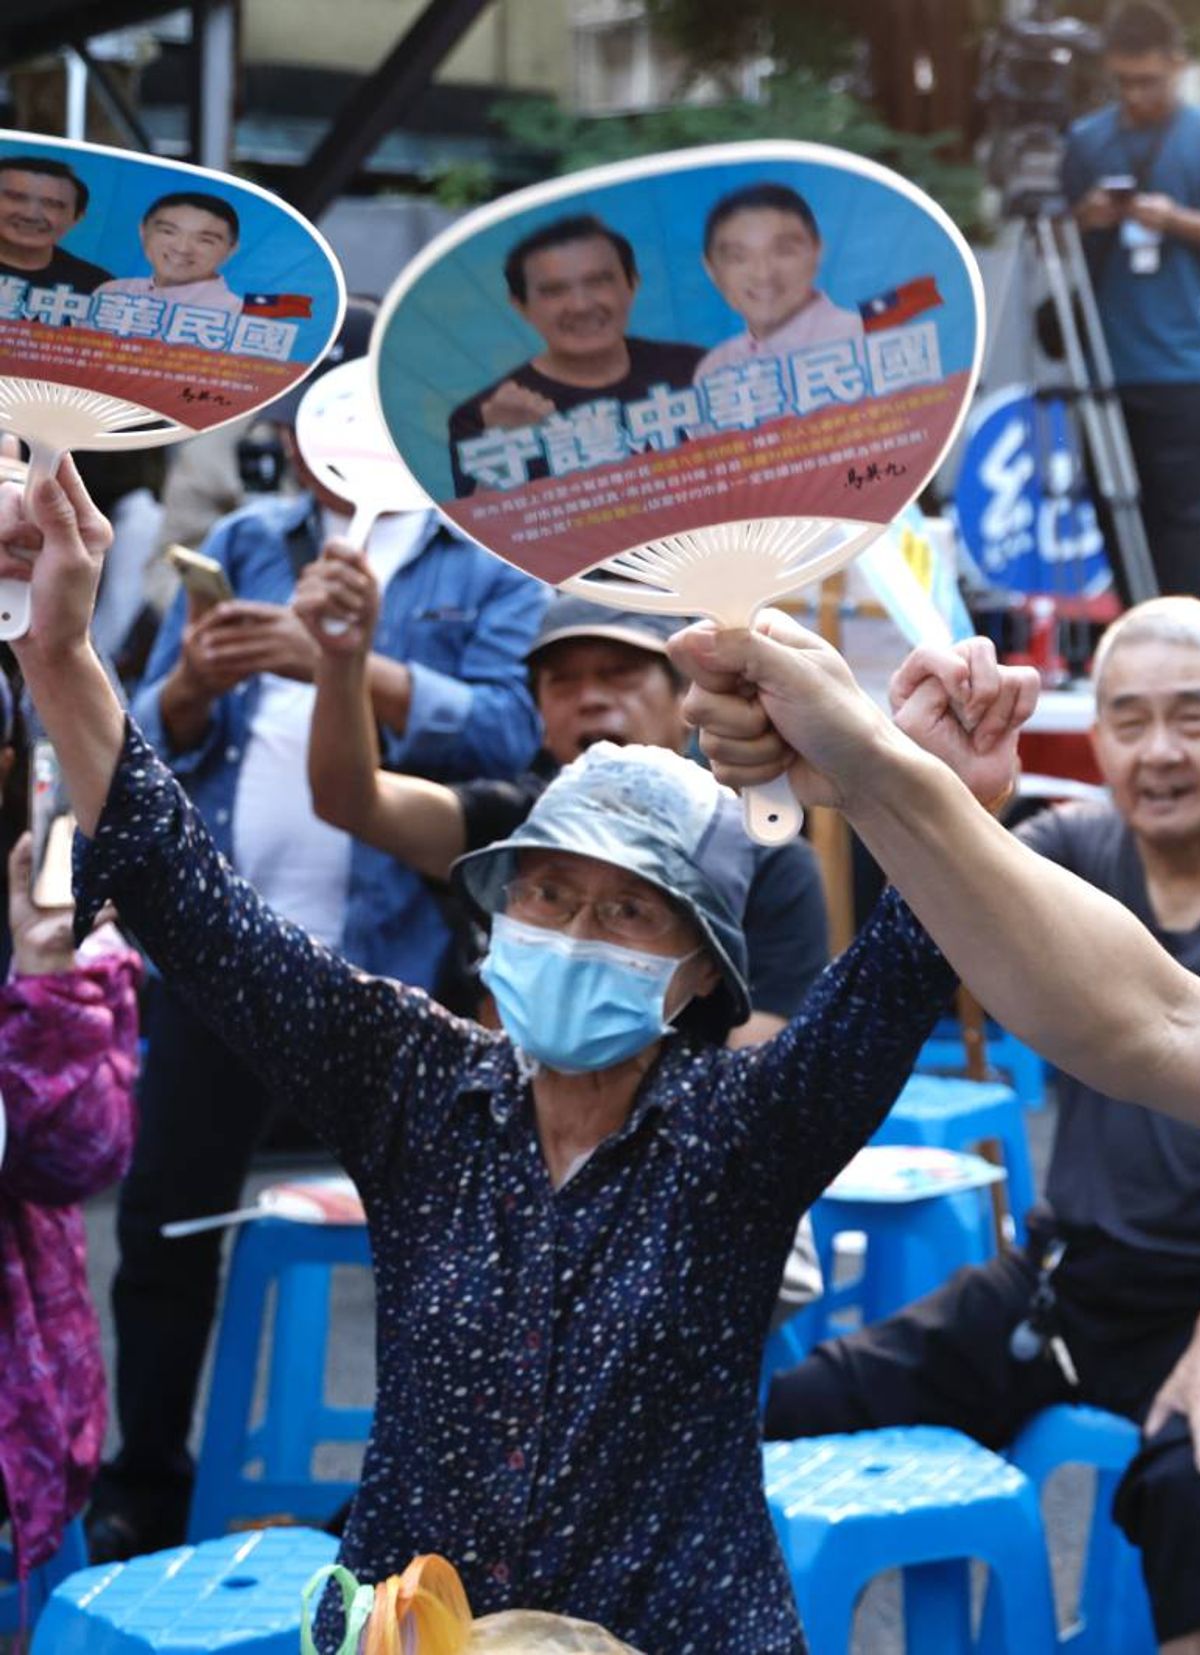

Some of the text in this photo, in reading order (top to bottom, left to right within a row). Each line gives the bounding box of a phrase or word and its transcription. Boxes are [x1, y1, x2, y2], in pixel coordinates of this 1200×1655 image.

[457, 321, 943, 490] 守護中華民國
